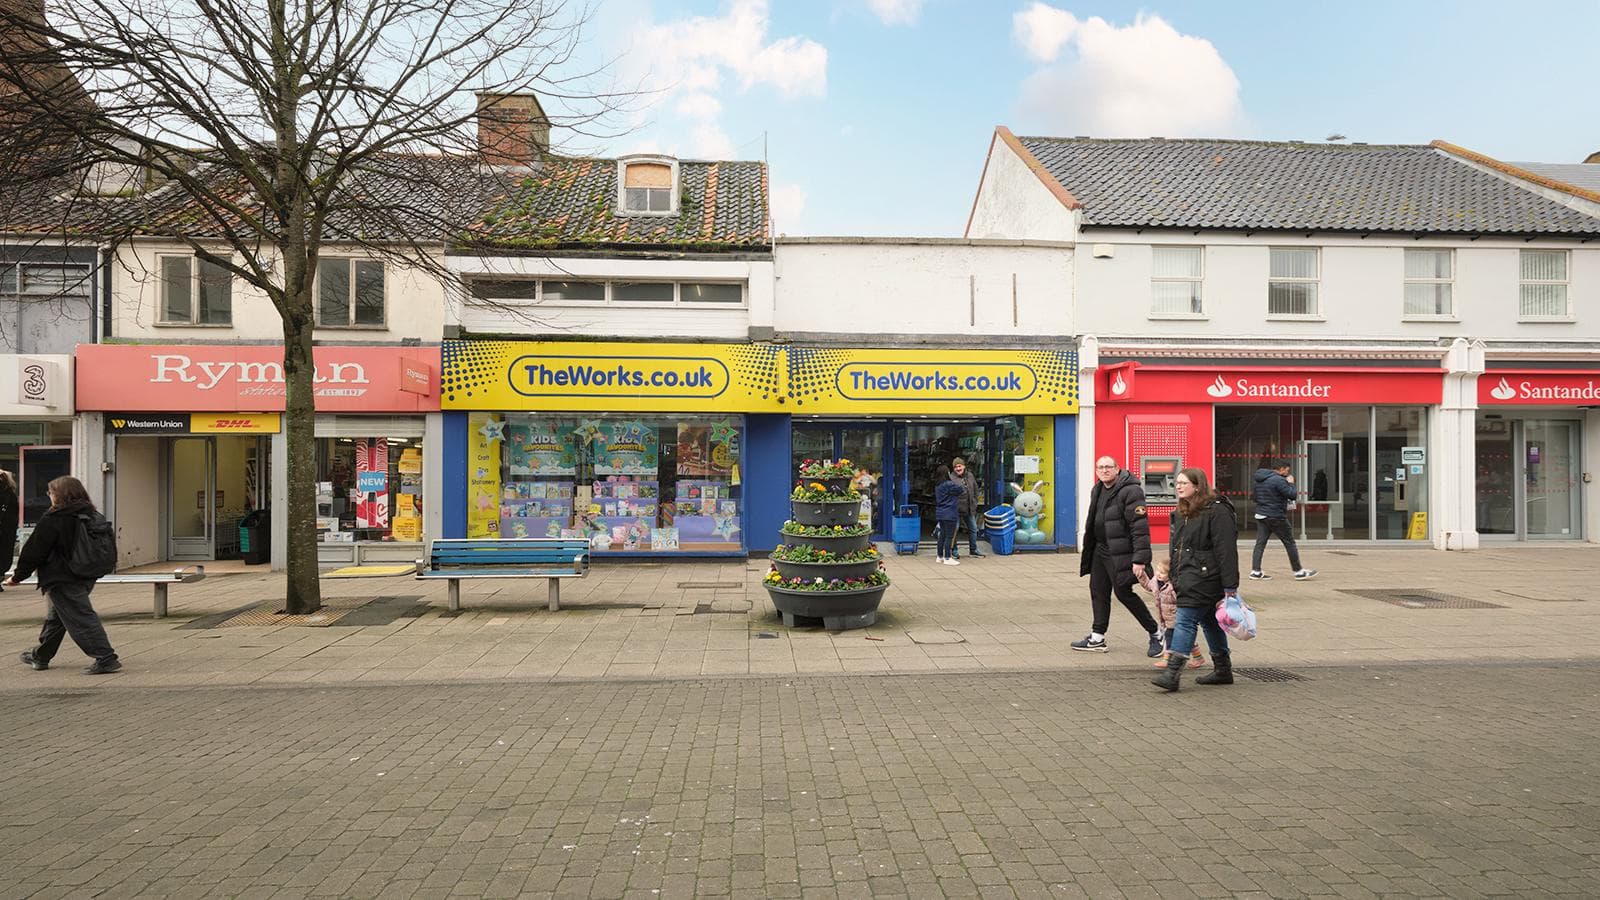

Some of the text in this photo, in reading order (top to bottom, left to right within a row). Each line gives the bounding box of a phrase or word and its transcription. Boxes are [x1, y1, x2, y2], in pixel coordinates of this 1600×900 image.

[24, 365, 46, 396] 3
[524, 363, 713, 387] TheWorks.co.uk
[850, 370, 1022, 391] TheWorks.co.uk
[1236, 378, 1332, 398] Santander
[127, 419, 184, 429] Western Union
[216, 419, 253, 429] DHL
[530, 435, 558, 444] KIDS
[360, 478, 385, 486] NEW
